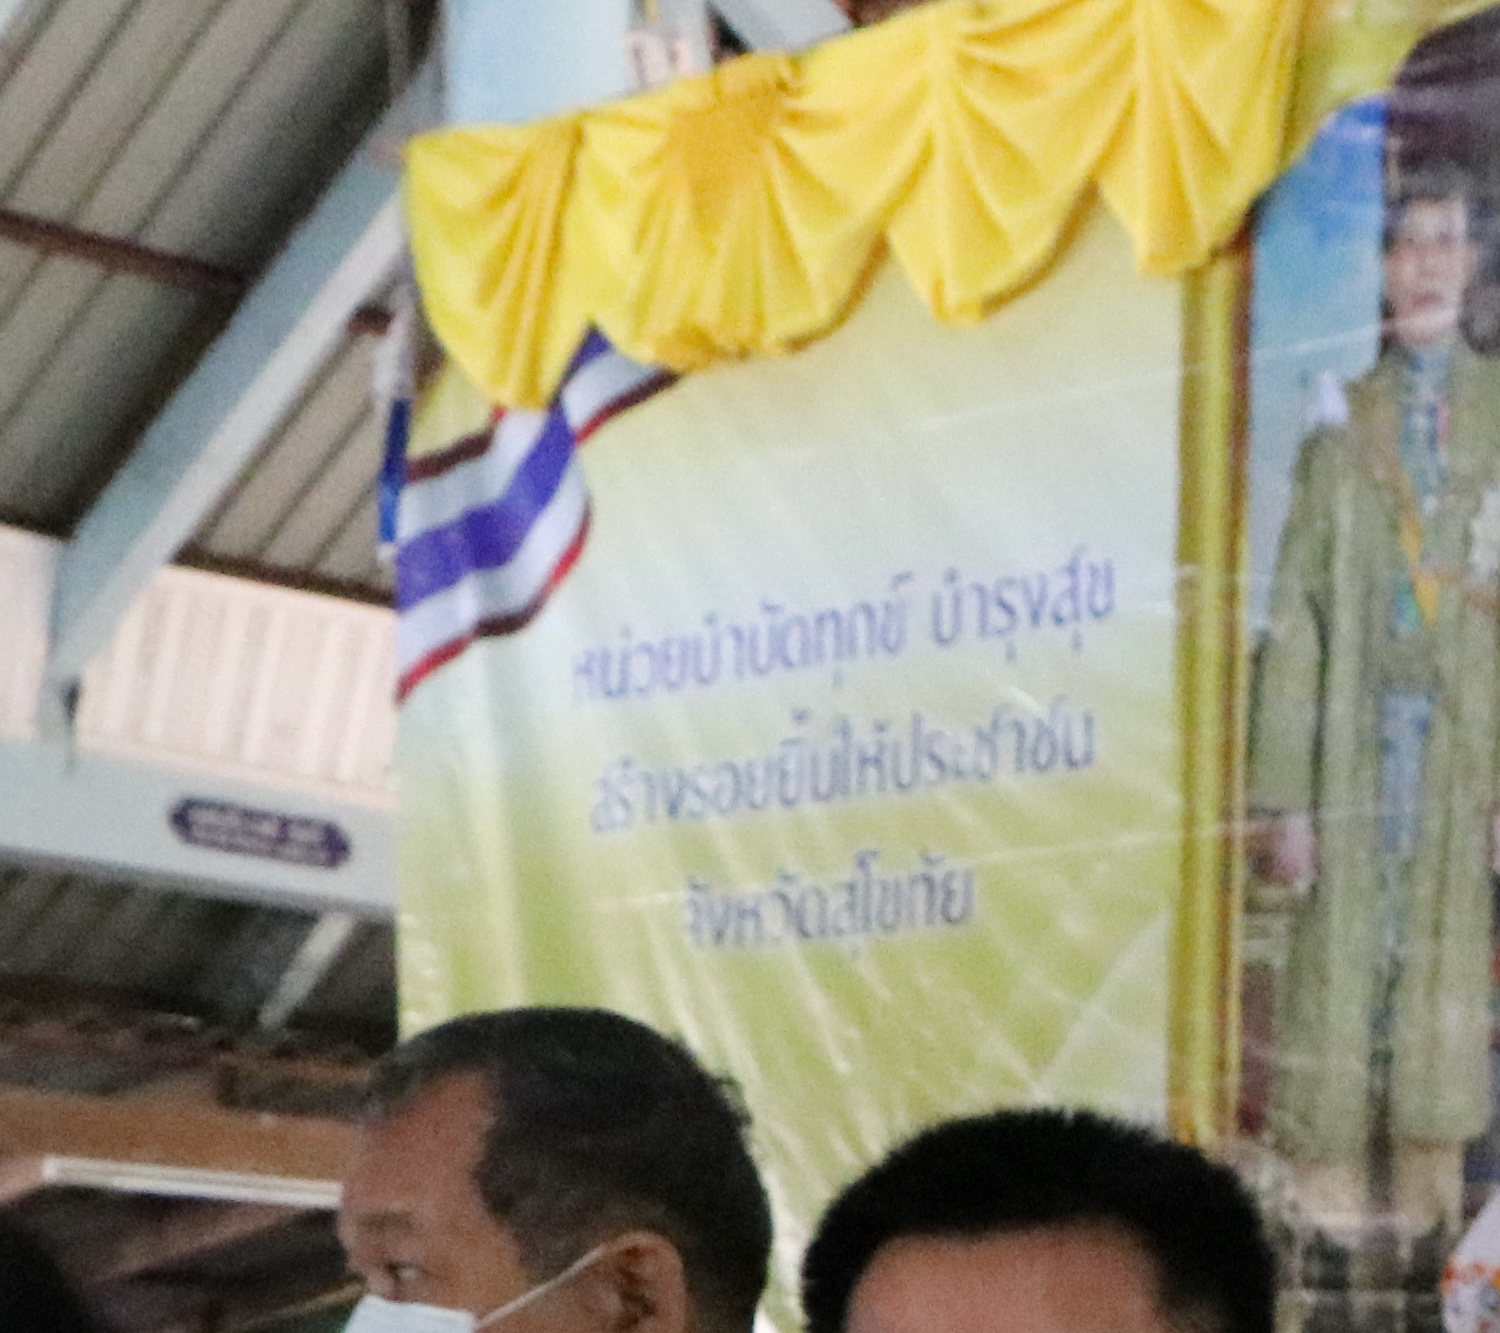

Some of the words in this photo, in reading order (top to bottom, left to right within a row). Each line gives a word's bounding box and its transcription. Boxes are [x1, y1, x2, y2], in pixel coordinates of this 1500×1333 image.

[931, 544, 1116, 663] บำรุงสุข
[685, 848, 978, 960] จังหวัดสุโขทัย
